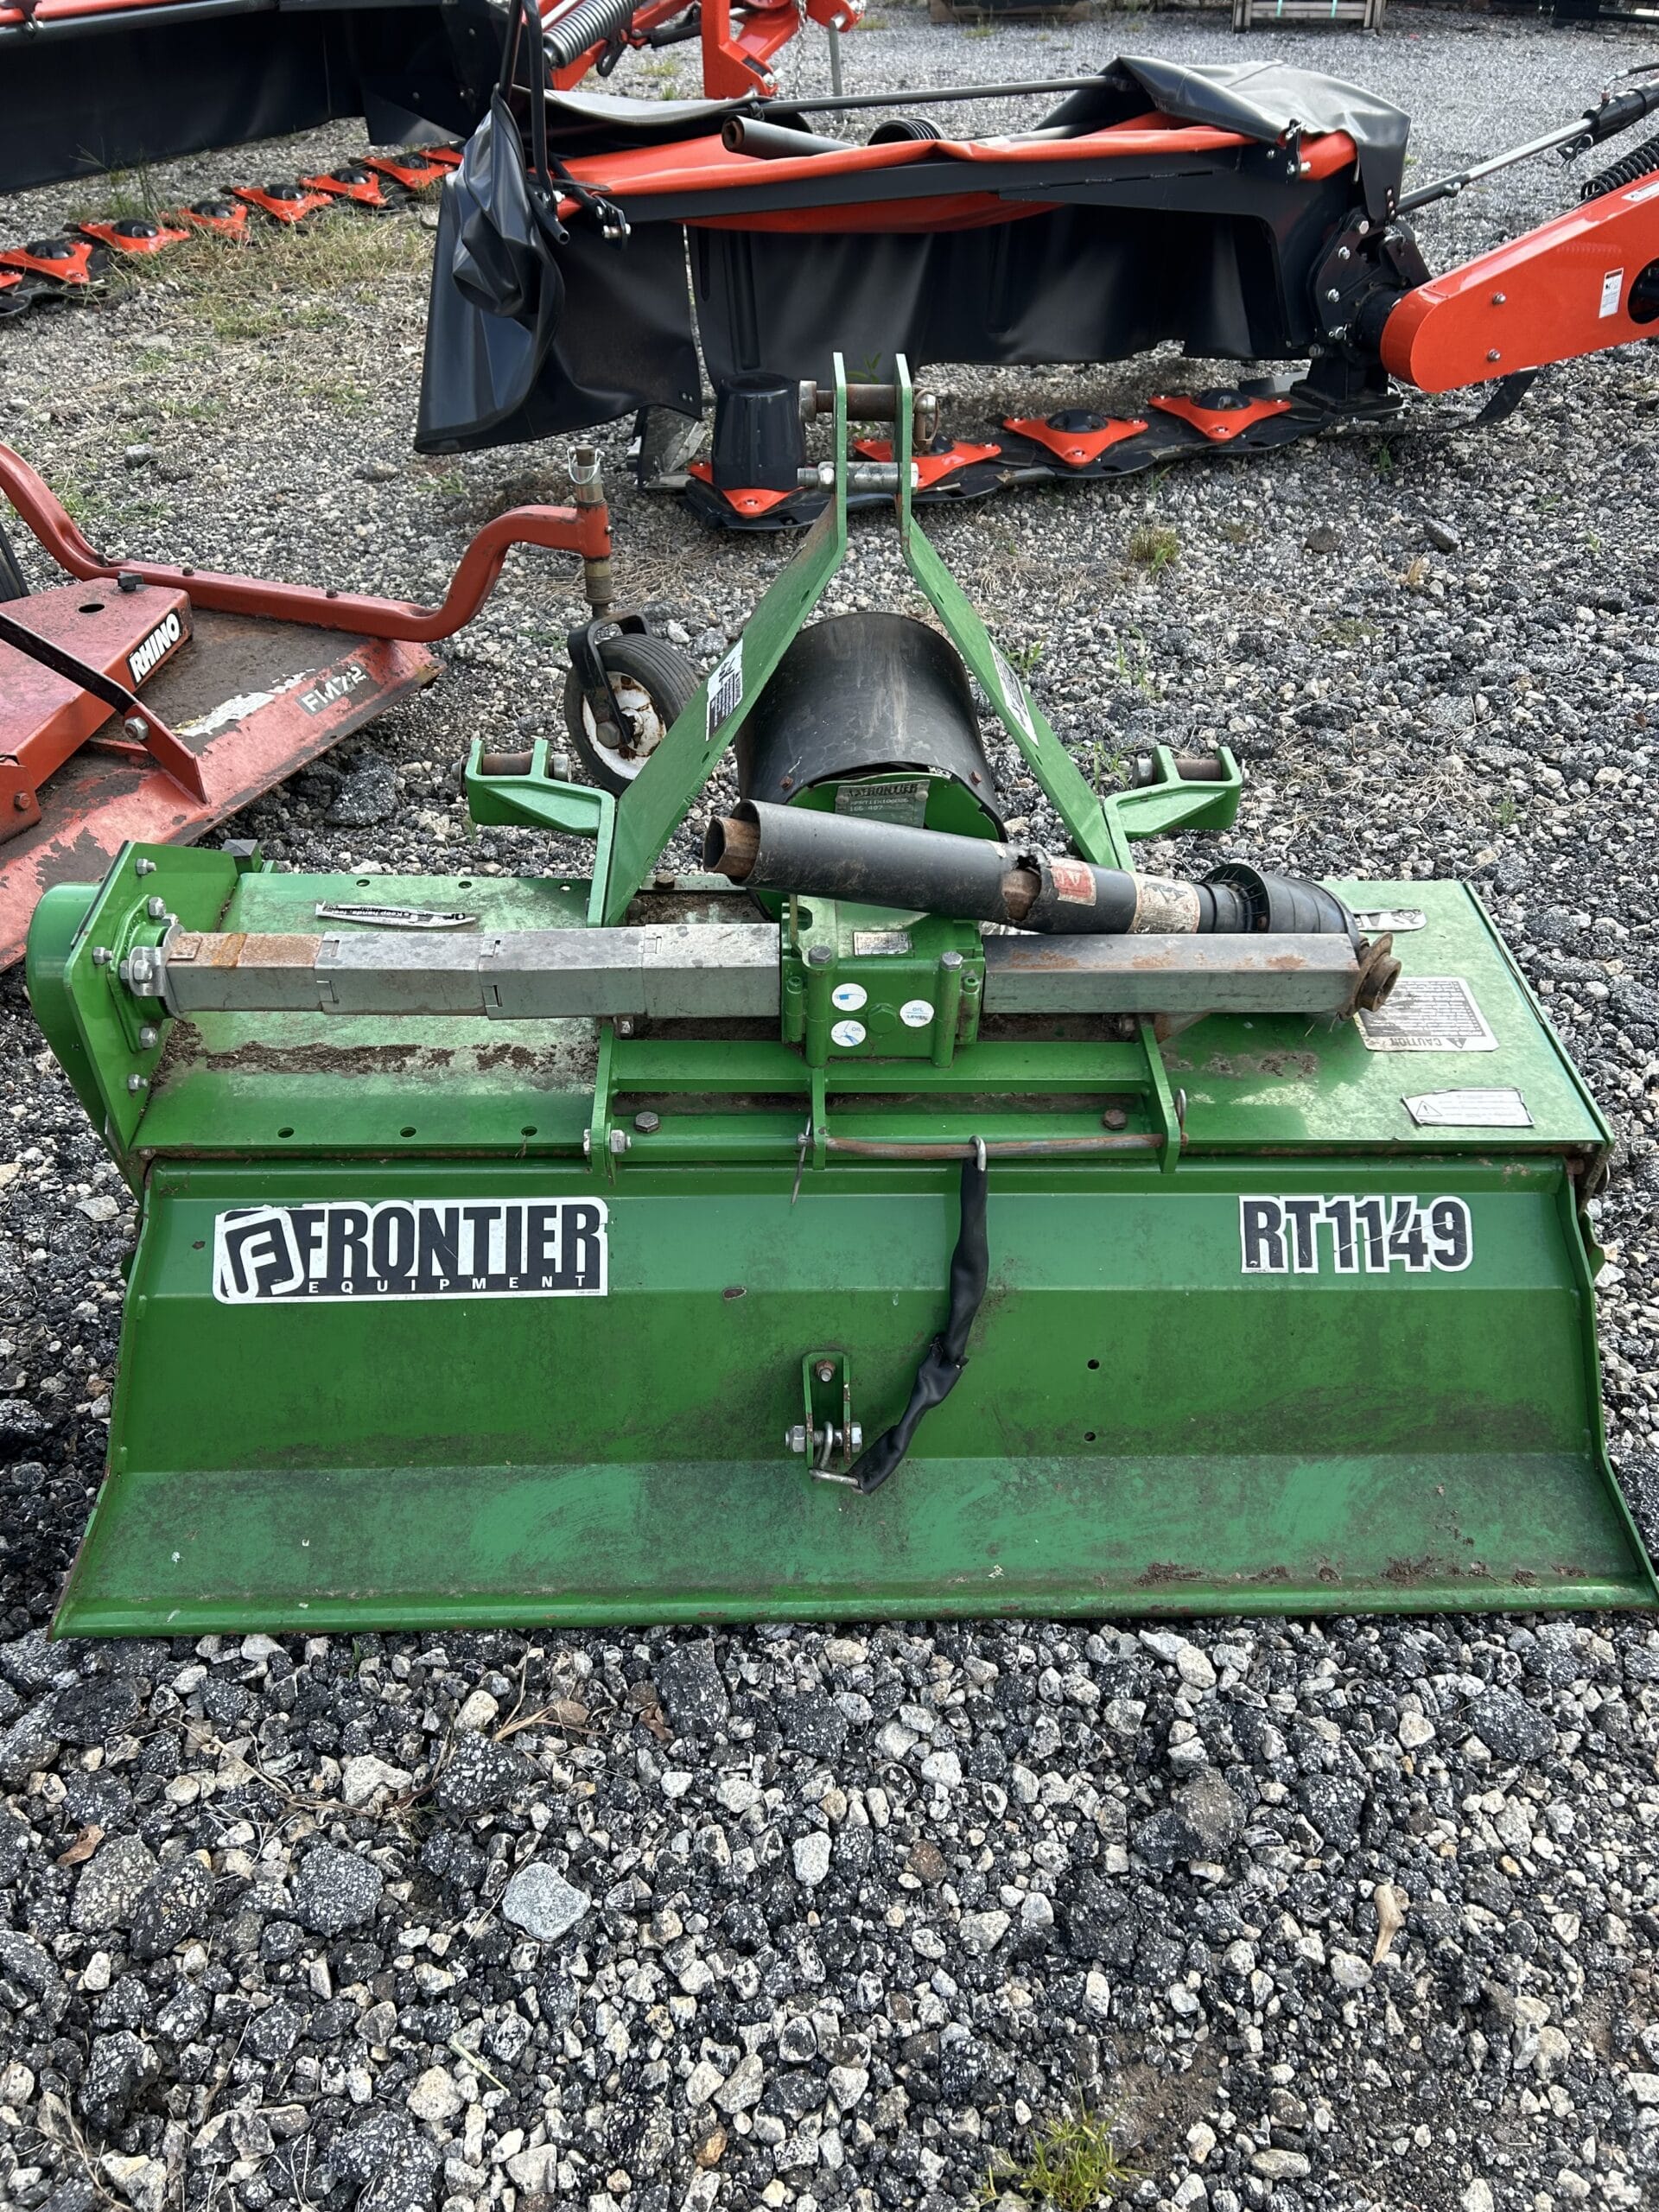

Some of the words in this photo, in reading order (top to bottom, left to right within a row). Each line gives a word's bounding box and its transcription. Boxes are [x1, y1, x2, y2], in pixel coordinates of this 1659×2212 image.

[129, 613, 181, 683] RHINO
[1389, 1037, 1442, 1046] CAUTION
[289, 1203, 601, 1279] FRONTIER
[1243, 1200, 1468, 1268] RT1149
[308, 1274, 587, 1294] EQUIPMENT
